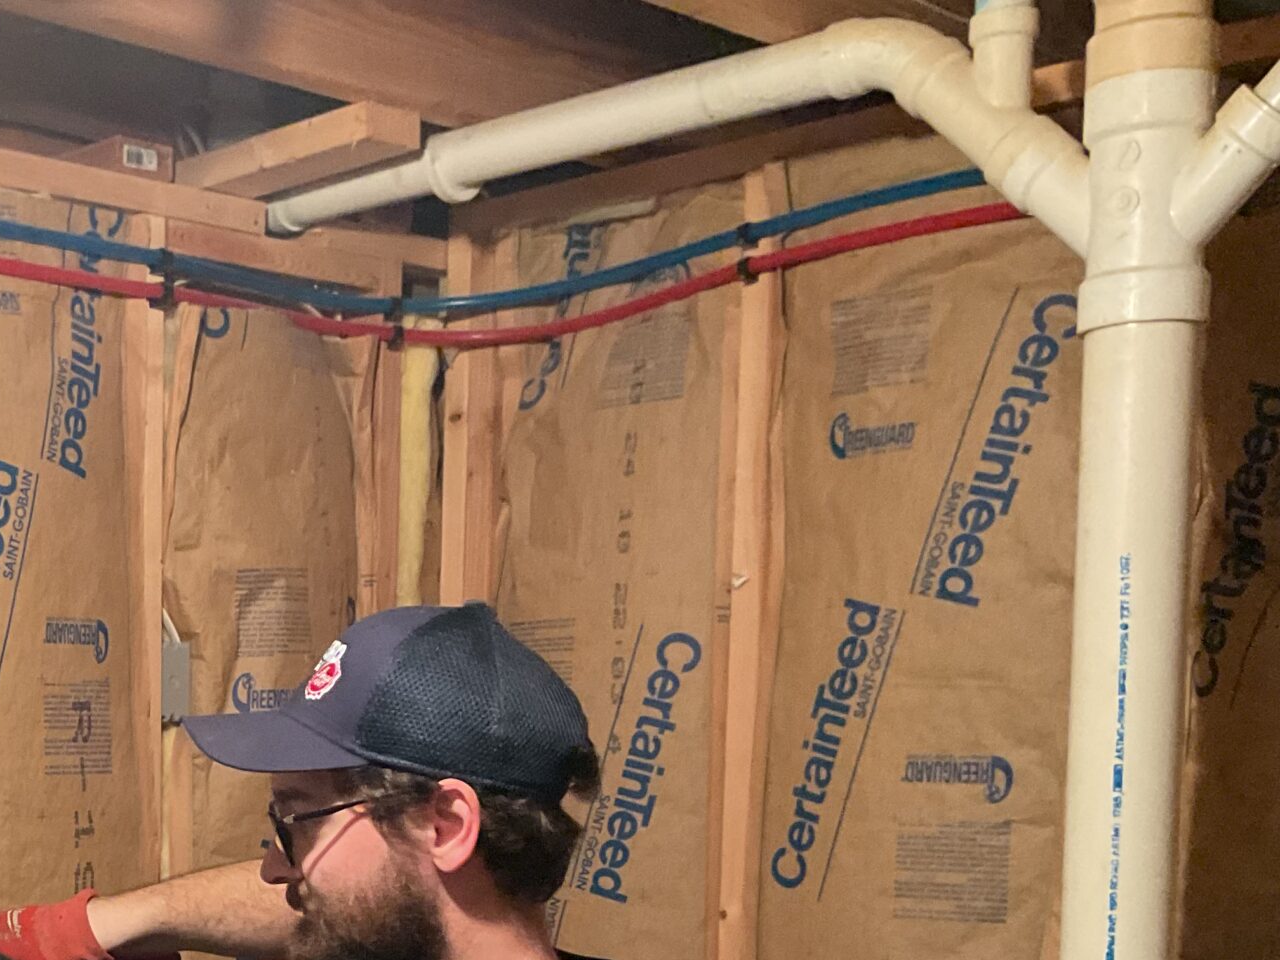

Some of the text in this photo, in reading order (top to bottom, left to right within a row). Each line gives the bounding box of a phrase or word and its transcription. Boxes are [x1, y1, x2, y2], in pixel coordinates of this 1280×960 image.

[934, 293, 1078, 608] CertainTeed
[3, 469, 33, 581] SAINT-GOBAIN
[919, 481, 965, 597] SAINT-GOBAIN
[854, 607, 897, 720] SAINT-GOBAIN
[589, 632, 703, 904] CertainTeed
[771, 597, 881, 890] CertainTeed
[902, 755, 1014, 804] GREENGUARD
